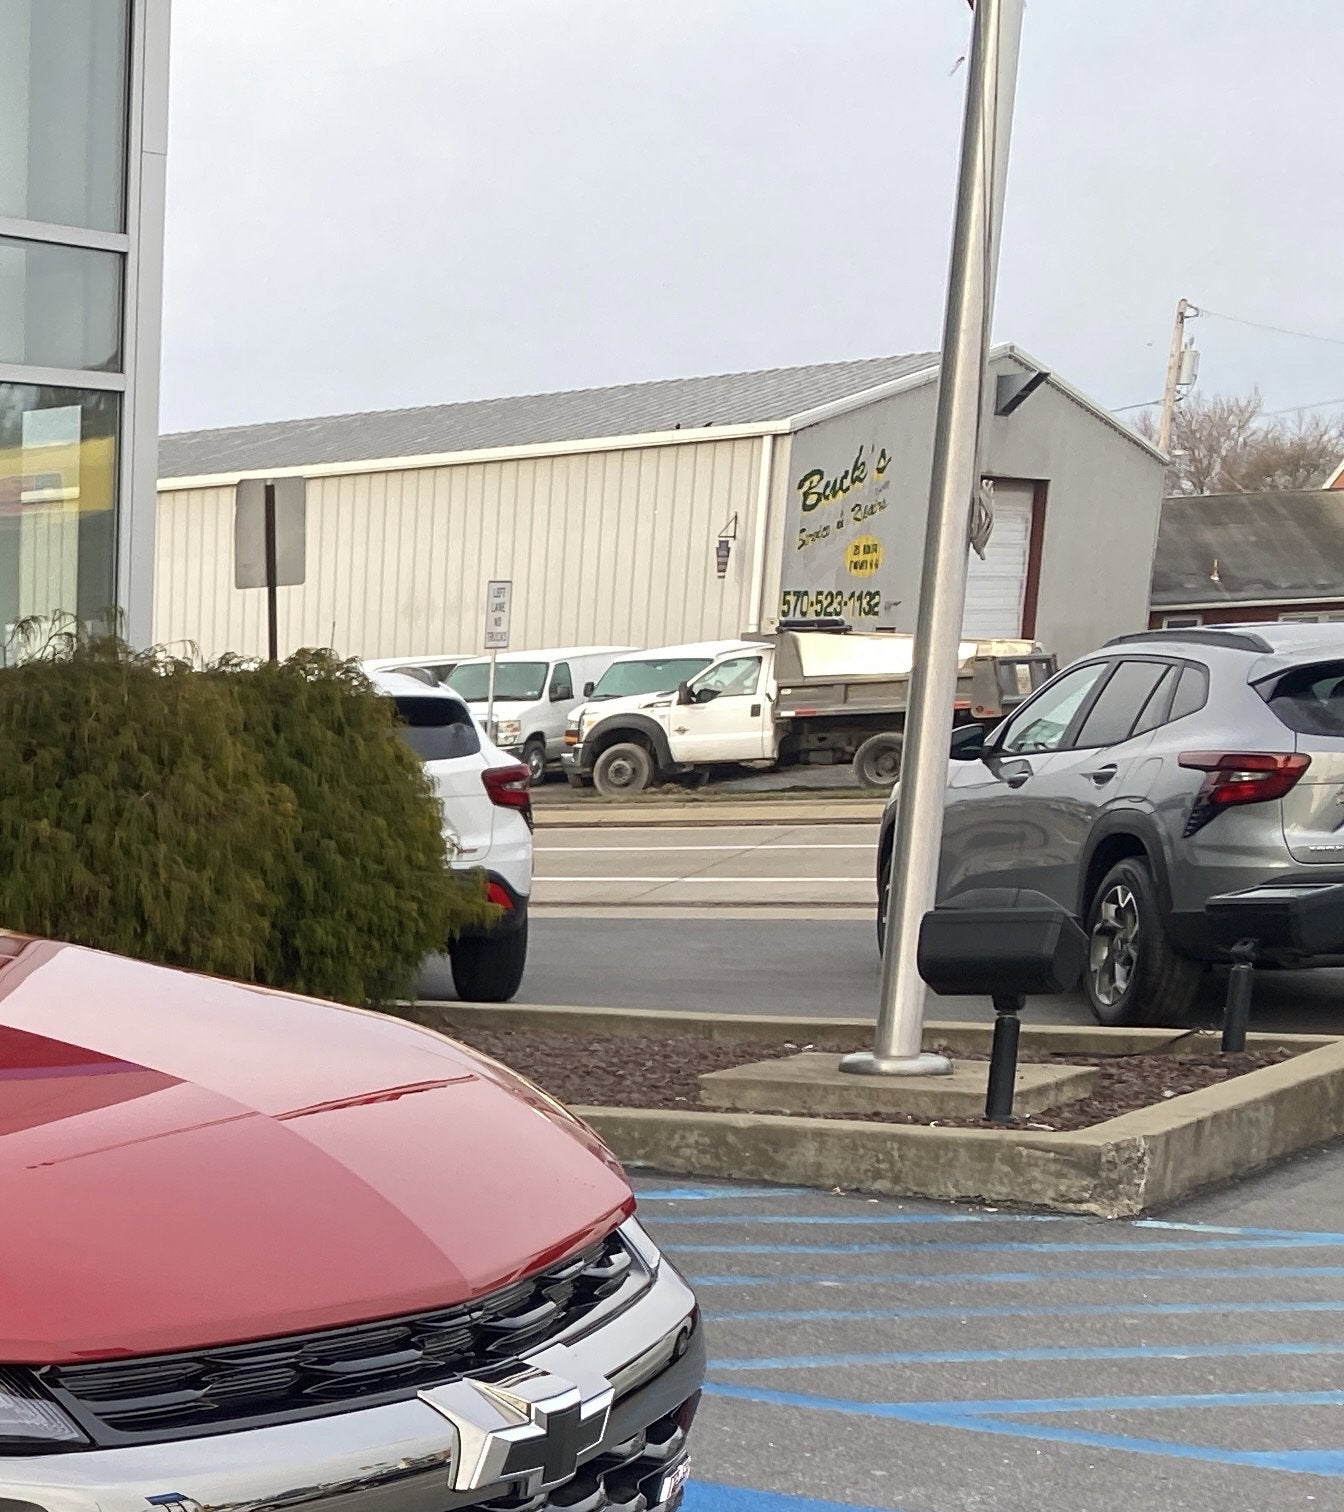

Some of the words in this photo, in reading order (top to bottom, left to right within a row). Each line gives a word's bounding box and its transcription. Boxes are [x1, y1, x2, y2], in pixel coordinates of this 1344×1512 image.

[797, 445, 892, 512] Buck's
[493, 587, 505, 598] LEFT
[491, 602, 505, 613] LANE
